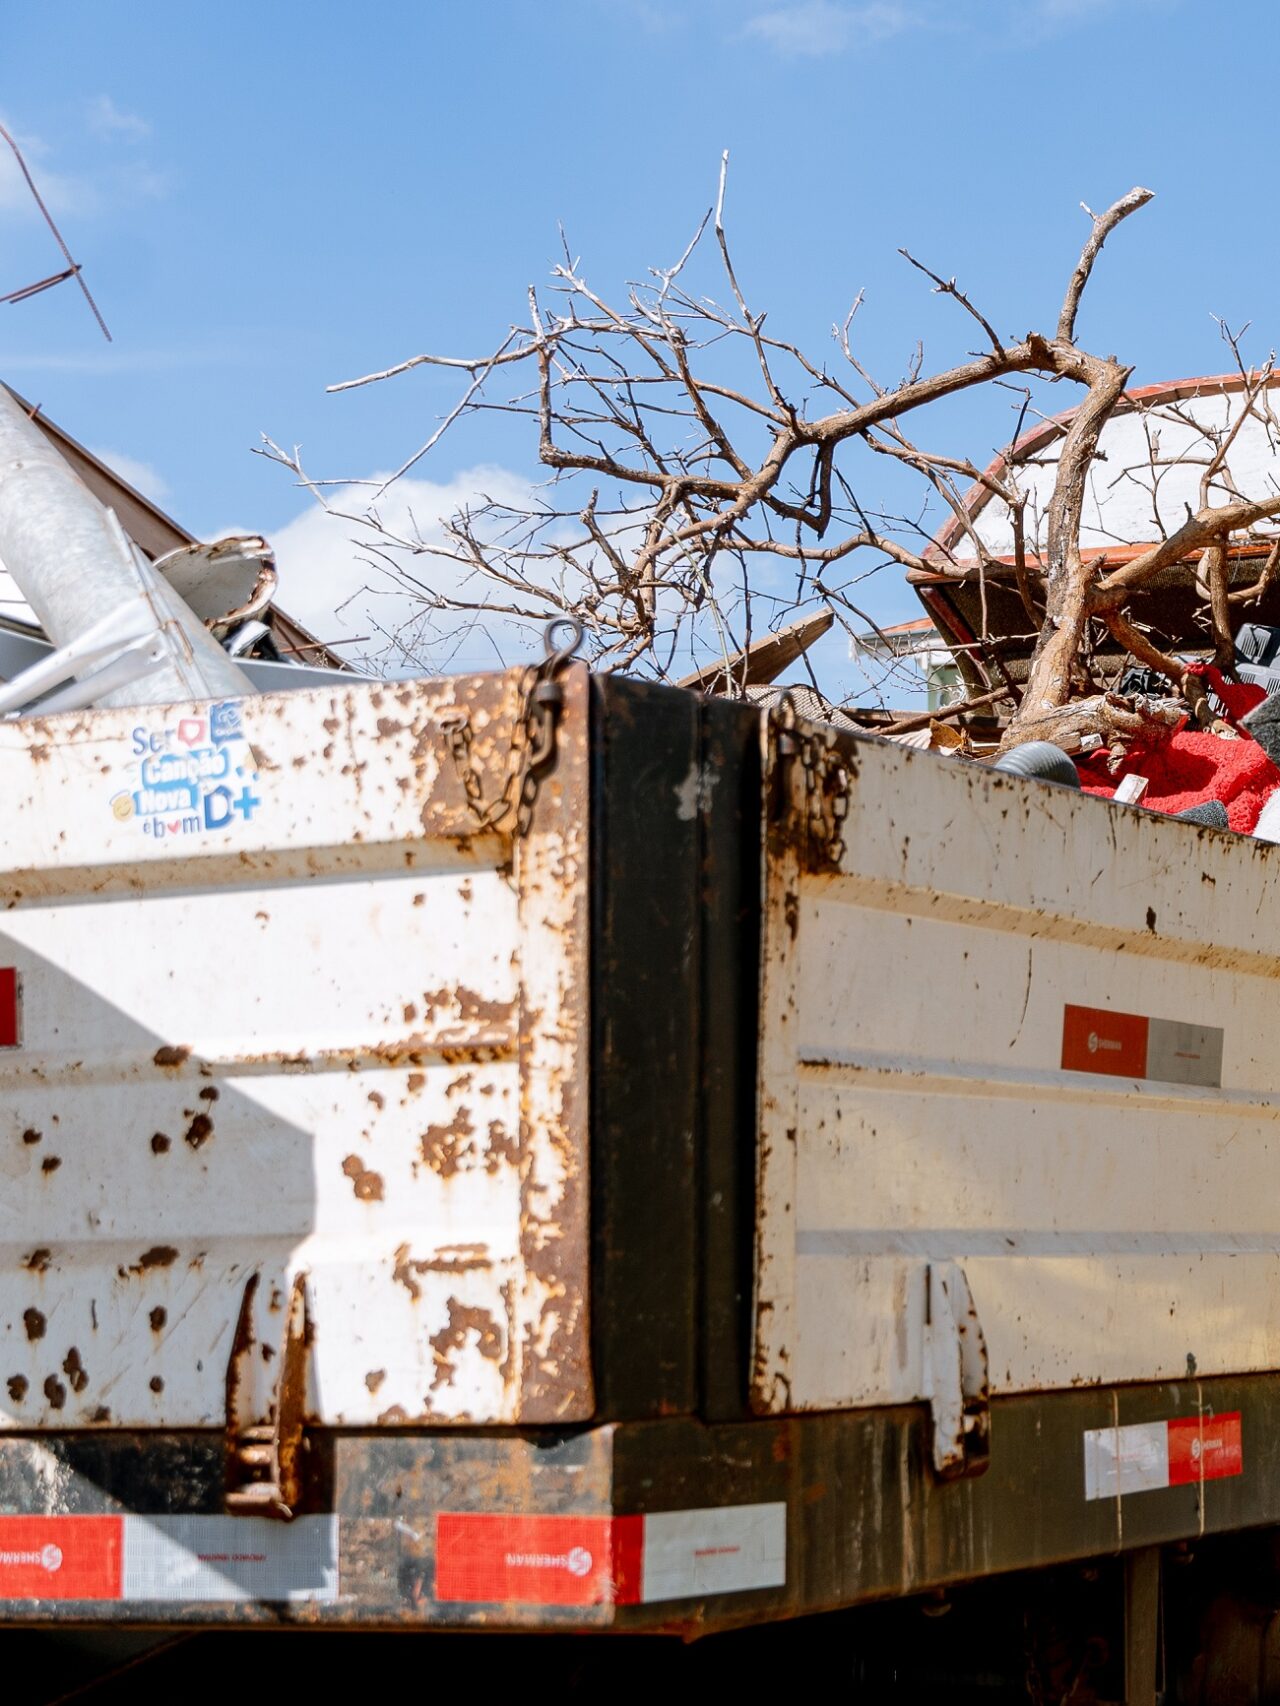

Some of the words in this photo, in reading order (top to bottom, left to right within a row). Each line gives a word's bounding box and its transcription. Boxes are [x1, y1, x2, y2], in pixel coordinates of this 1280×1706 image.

[132, 727, 175, 755] Ser
[138, 788, 192, 814] Nova
[0, 1551, 42, 1565] SHERMA
[505, 1551, 568, 1568] SHERMAN
